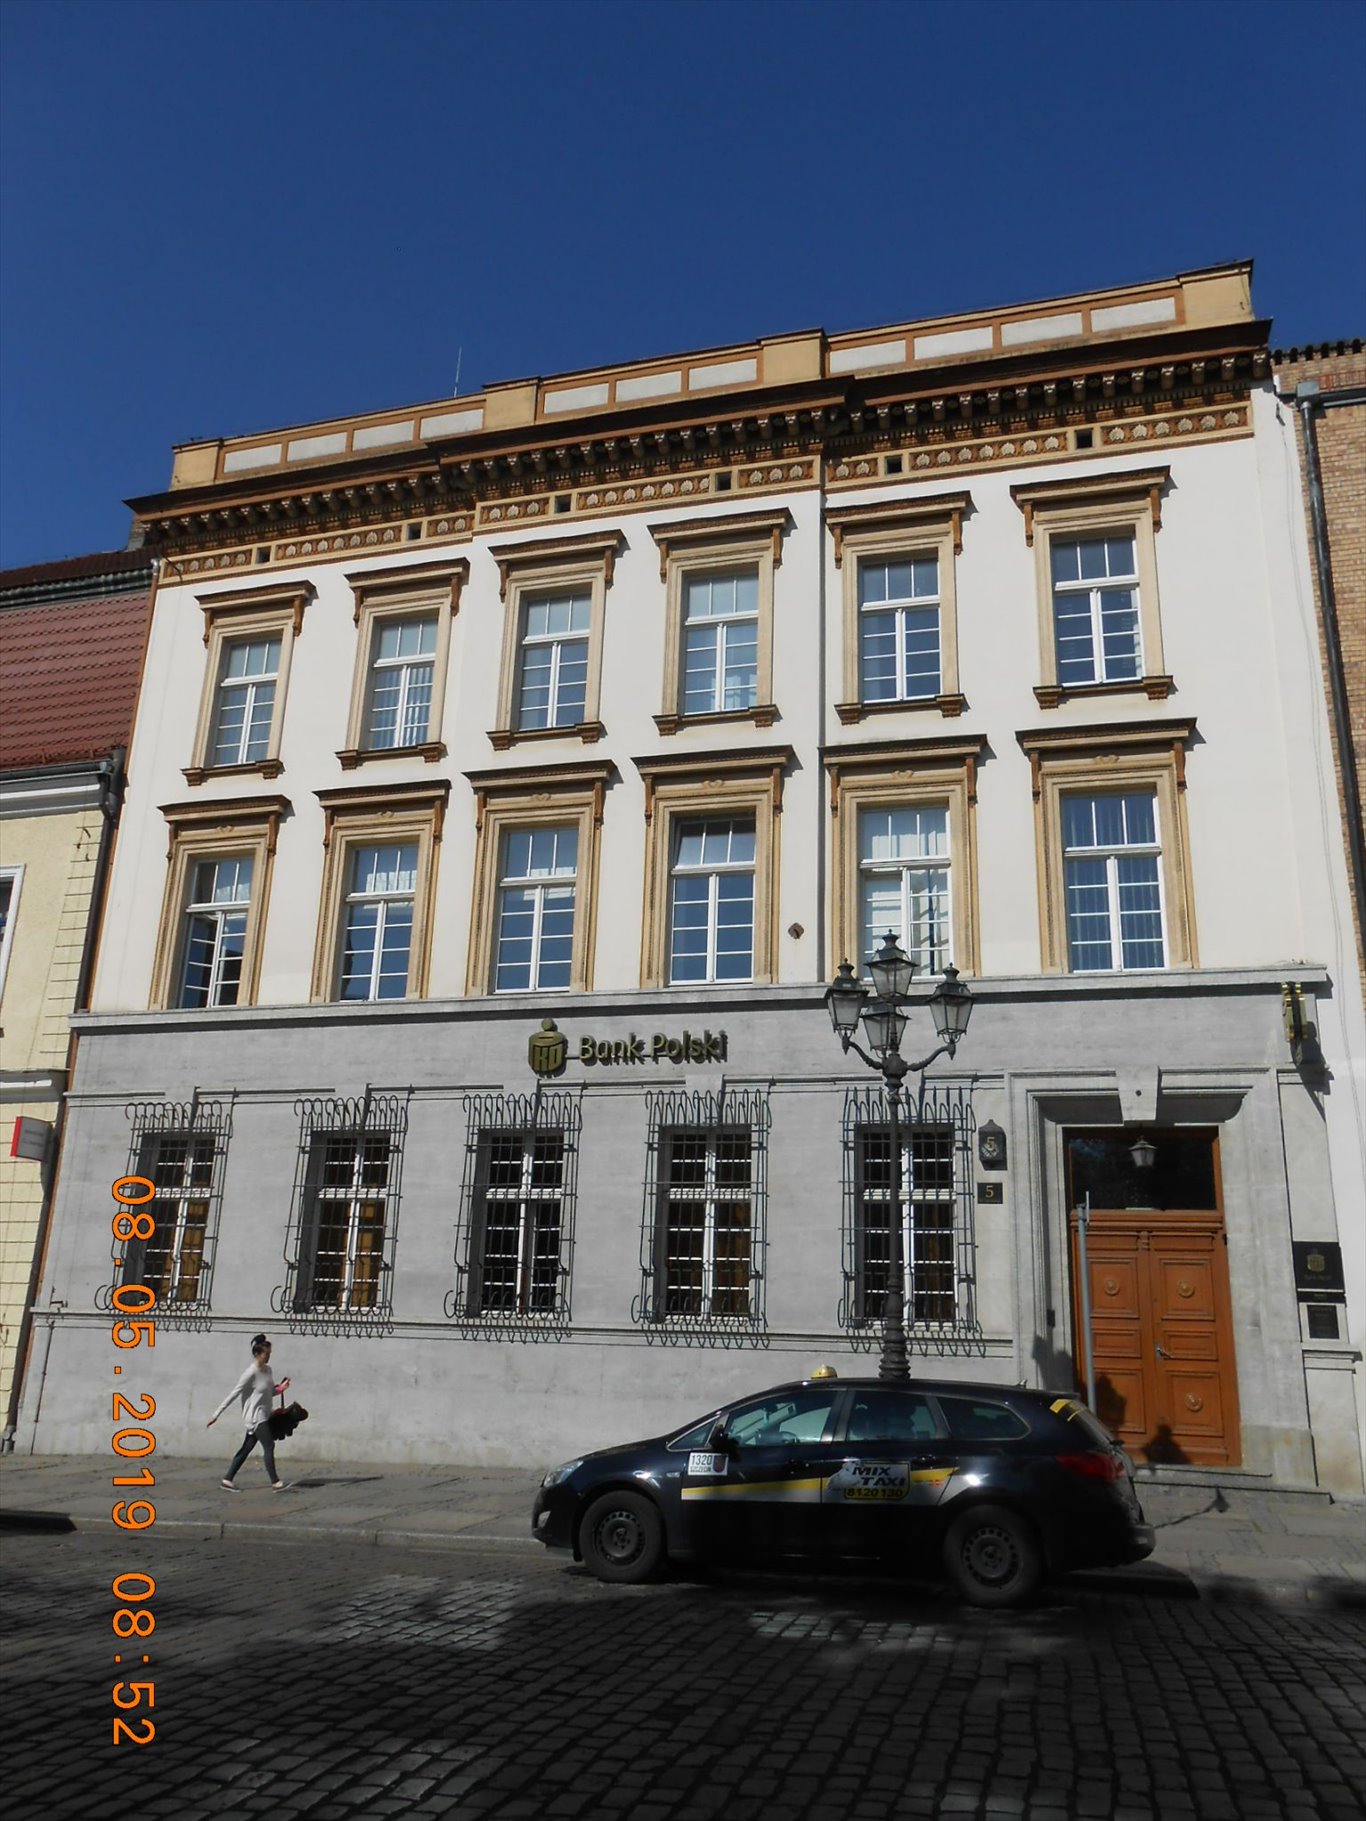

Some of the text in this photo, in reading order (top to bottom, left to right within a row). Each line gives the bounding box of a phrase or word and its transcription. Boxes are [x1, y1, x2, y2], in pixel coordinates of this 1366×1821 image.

[580, 1030, 728, 1063] Bank Polski
[985, 1136, 997, 1151] 5
[985, 1185, 995, 1198] 5
[692, 1454, 713, 1466] 1320
[852, 1466, 891, 1476] MIX
[861, 1476, 906, 1487] TAXI
